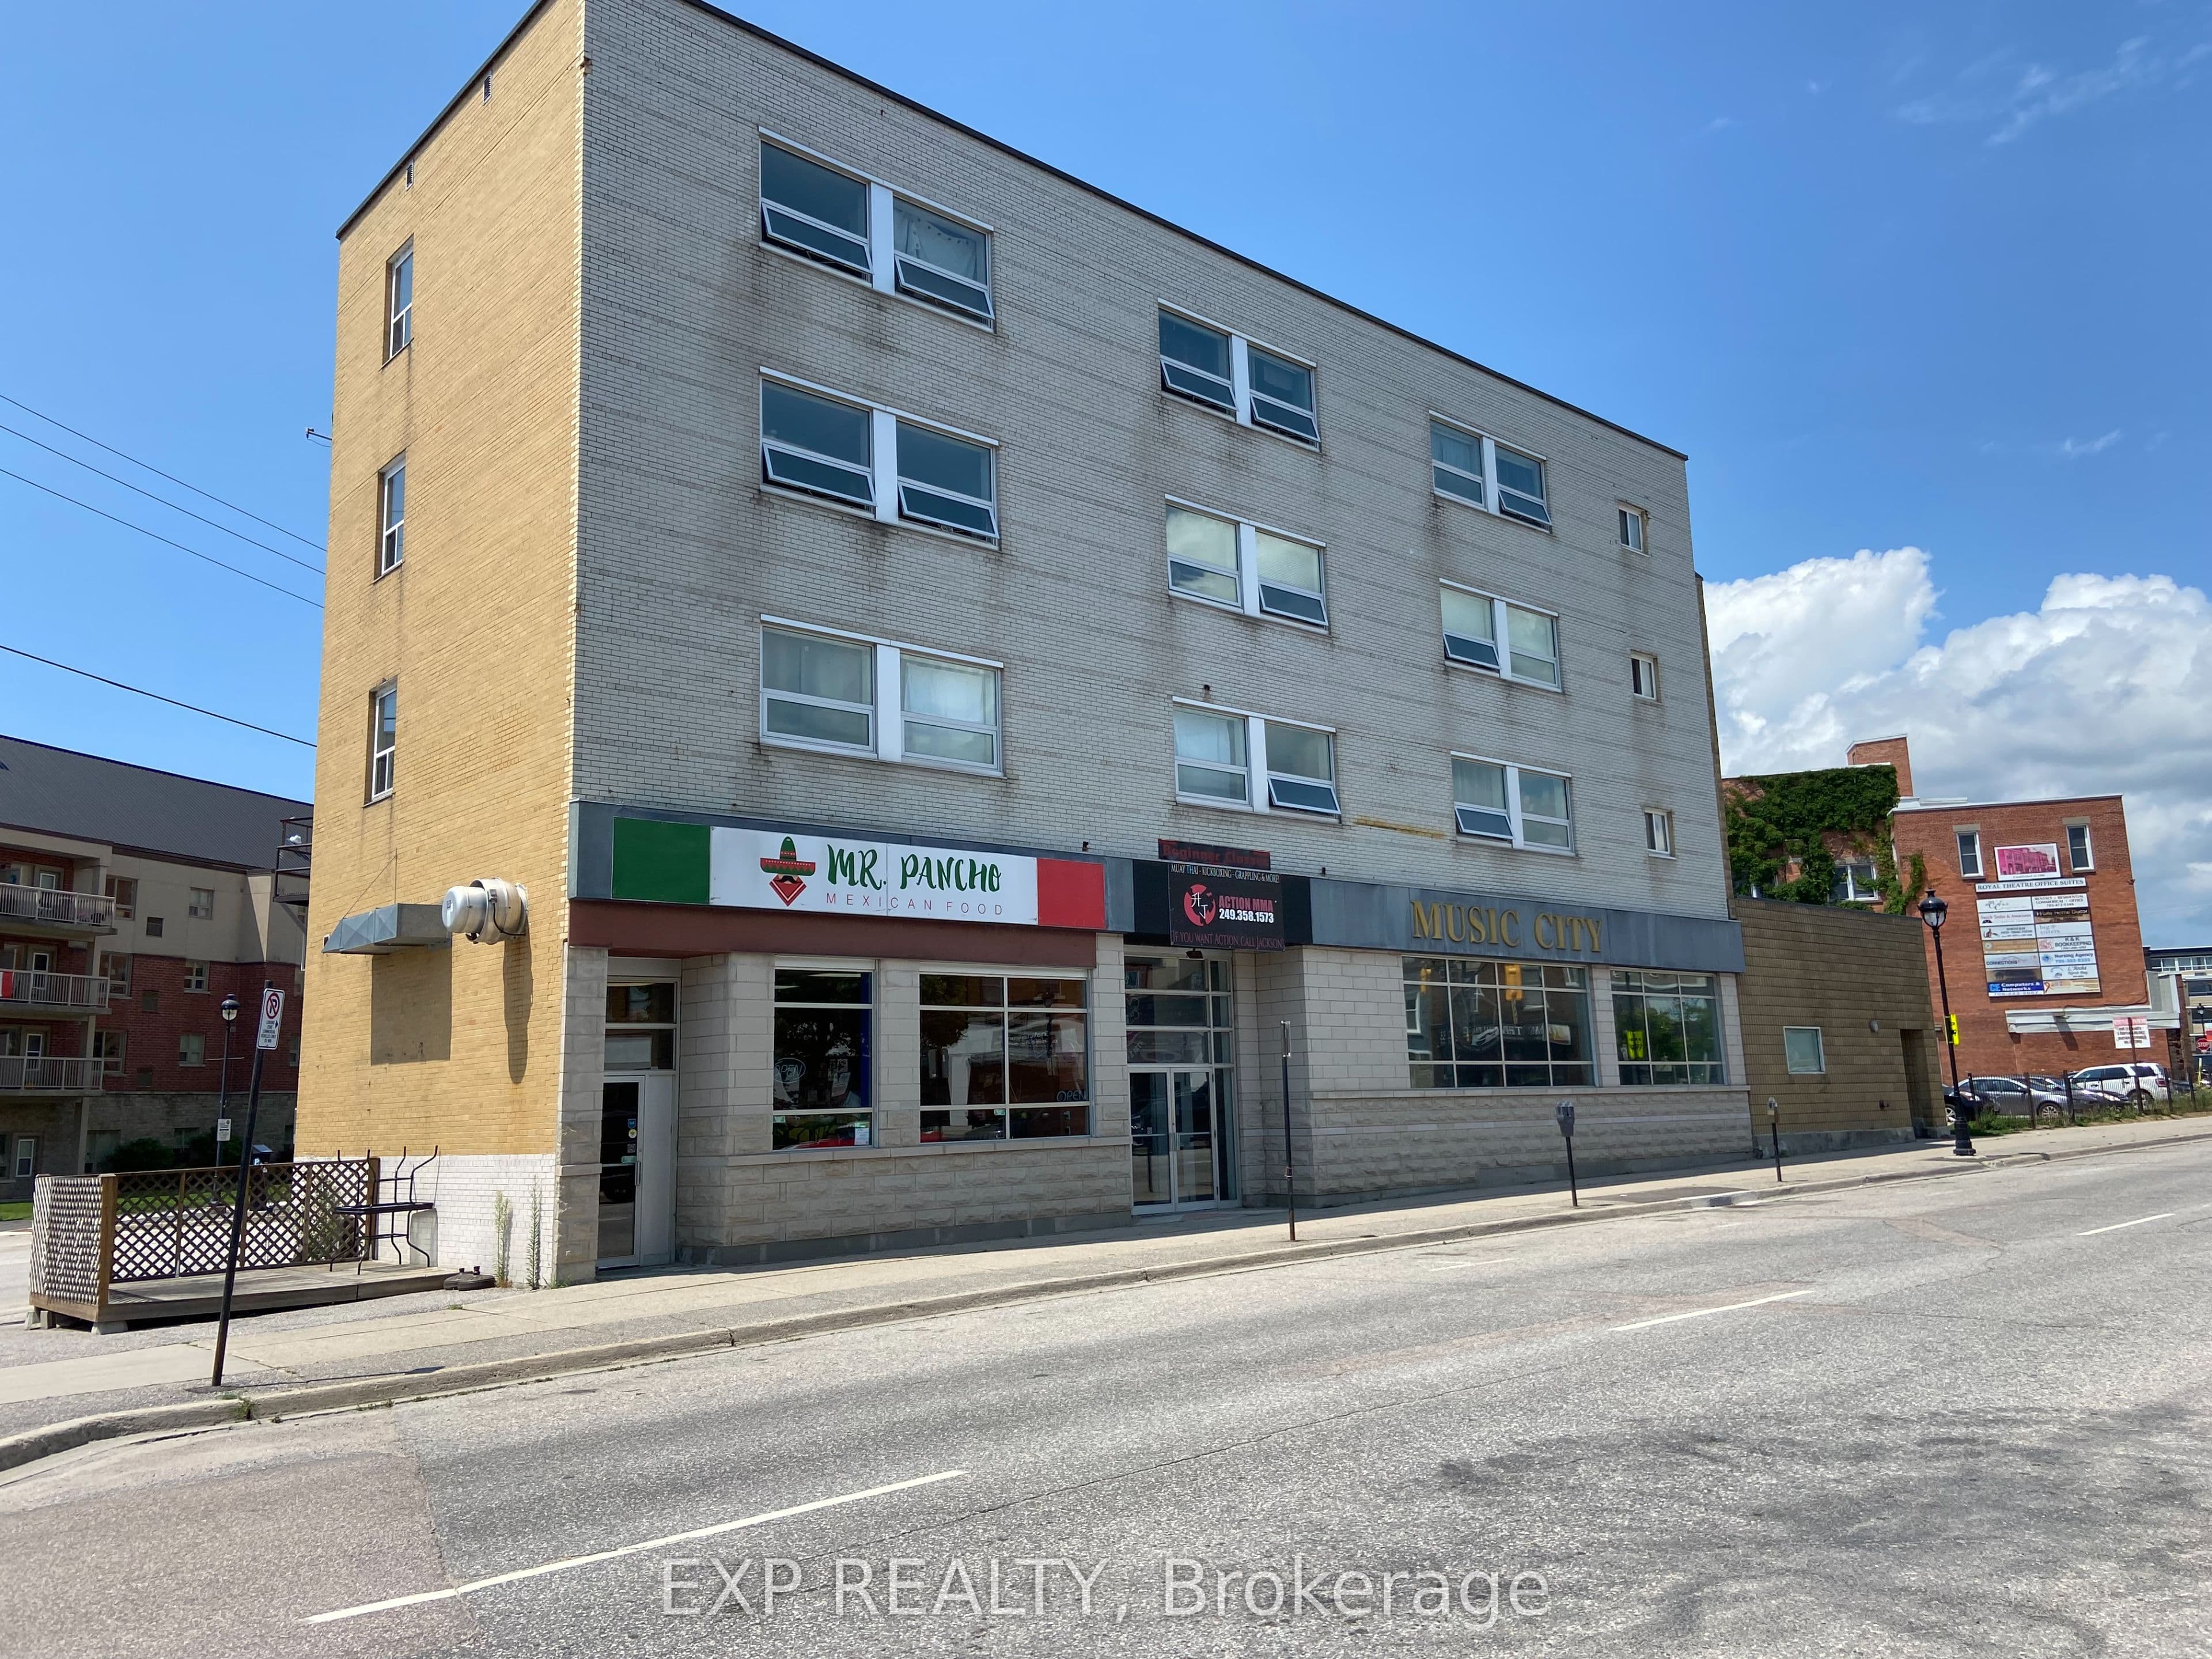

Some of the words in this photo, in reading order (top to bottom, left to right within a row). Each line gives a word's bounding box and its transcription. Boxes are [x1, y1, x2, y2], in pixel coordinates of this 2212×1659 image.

[827, 843, 887, 891] MR.
[900, 853, 1002, 892] PANCHO
[1171, 863, 1185, 873] MUAY
[1187, 865, 1198, 874] THAI
[1202, 866, 1232, 878] KICKBOXING
[1235, 870, 1261, 881] GRAPPLING
[1262, 873, 1266, 882] &
[826, 892, 931, 911] MEXICAN
[946, 901, 1002, 915] FOOD
[1219, 895, 1251, 911] ACTION
[1252, 898, 1274, 912] MMA
[1219, 908, 1274, 923] 249.358.1573
[1410, 899, 1520, 948] MUSIC
[1534, 912, 1603, 952] CITY
[1180, 931, 1194, 943] YOU
[1194, 933, 1213, 945] WANT
[1214, 933, 1238, 946] ACTION
[1240, 935, 1256, 947] CALL
[773, 1064, 802, 1078] OPEN
[1056, 1089, 1088, 1102] OPEN
